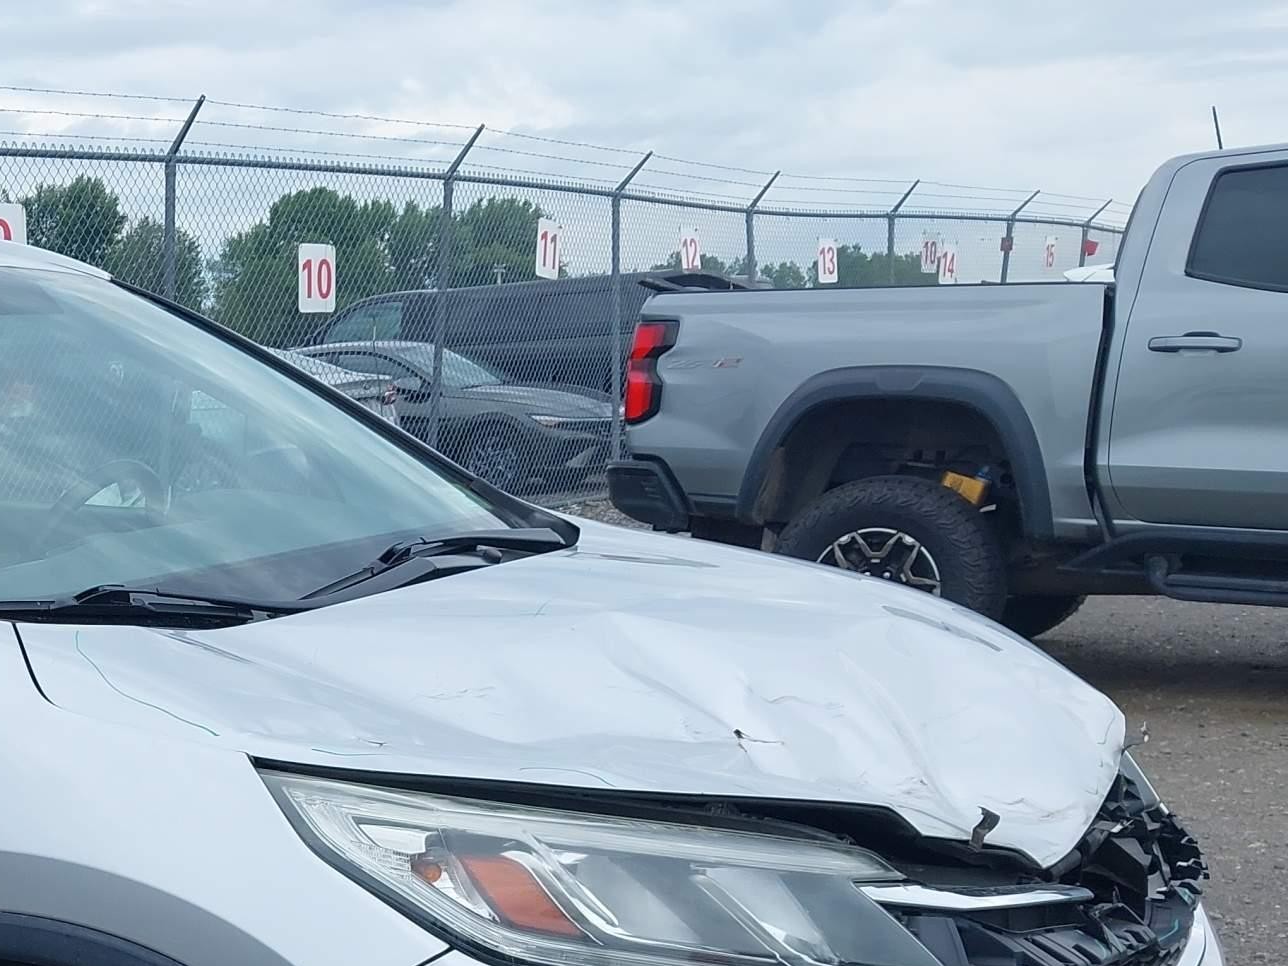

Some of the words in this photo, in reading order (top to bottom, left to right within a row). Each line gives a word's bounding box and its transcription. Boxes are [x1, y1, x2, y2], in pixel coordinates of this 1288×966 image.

[540, 230, 558, 270] 11
[682, 238, 699, 272] 12
[819, 247, 836, 275] 13
[923, 240, 937, 265] 10
[942, 251, 956, 278] 14
[302, 258, 332, 300] 10
